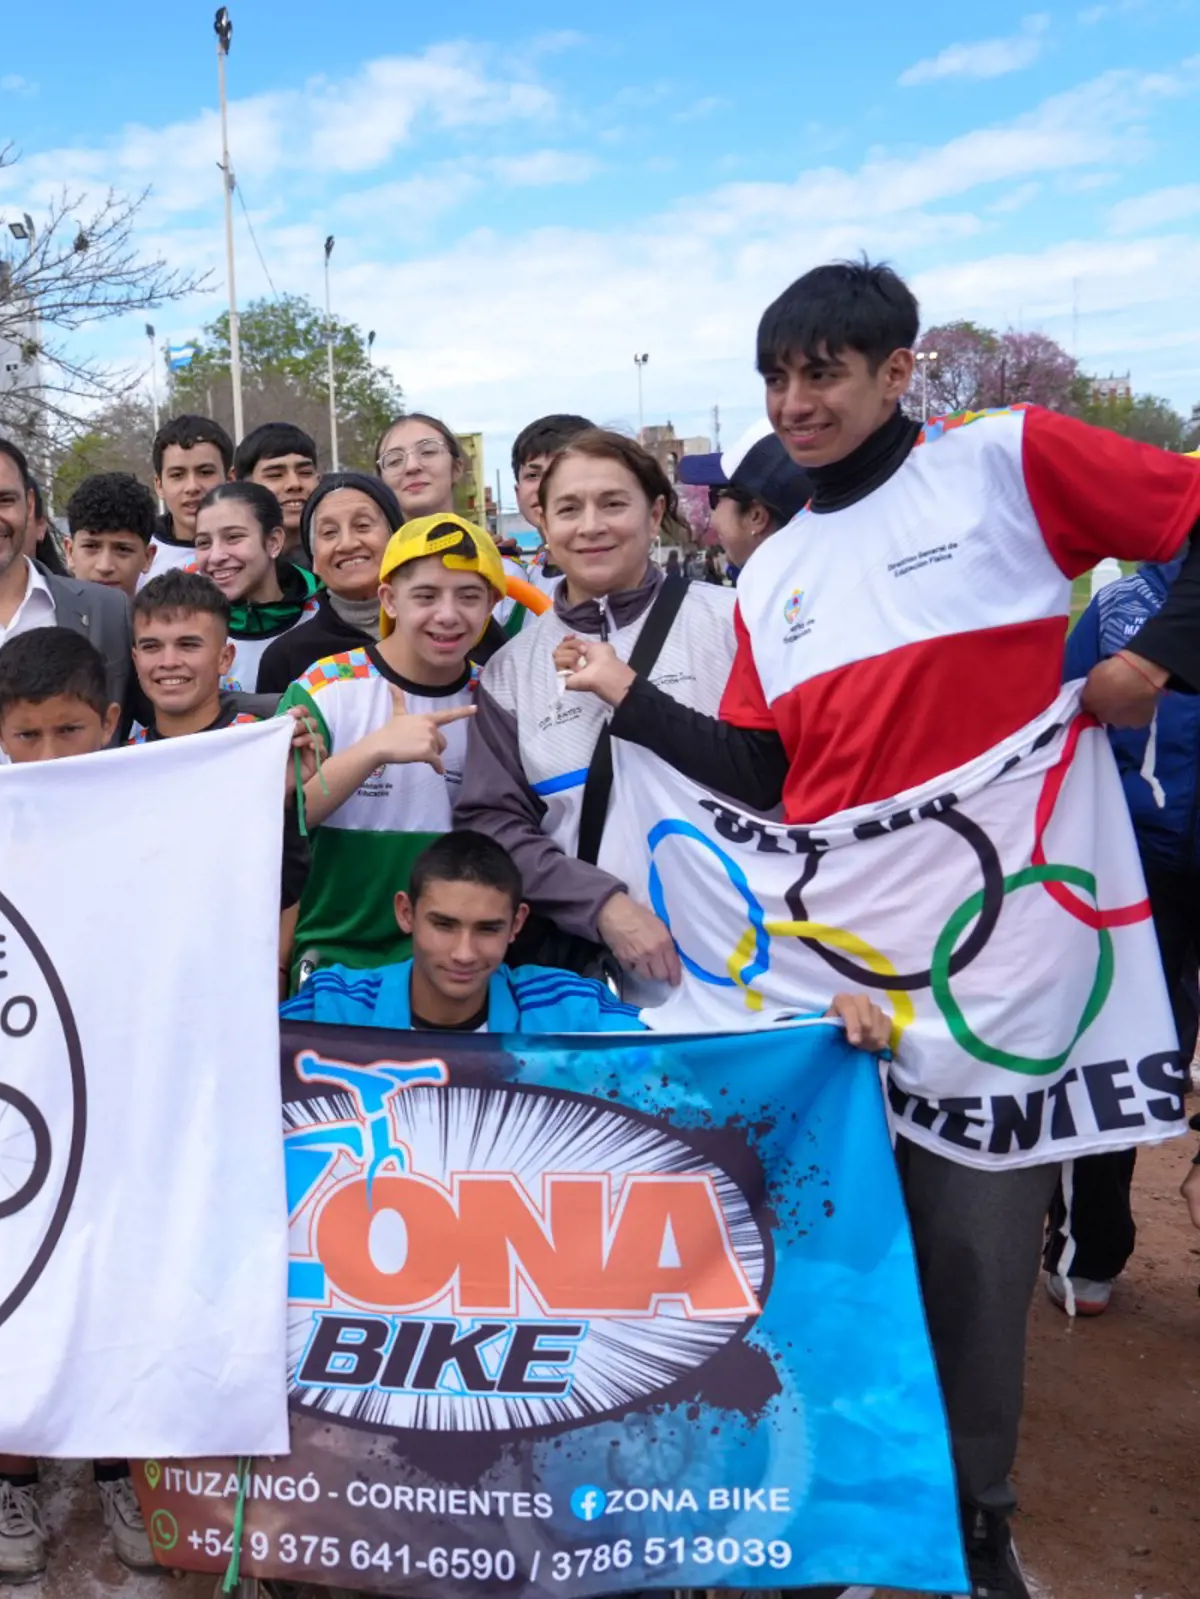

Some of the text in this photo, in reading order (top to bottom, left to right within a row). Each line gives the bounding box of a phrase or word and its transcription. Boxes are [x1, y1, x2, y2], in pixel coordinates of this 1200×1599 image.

[888, 1050, 1188, 1154] IENTES
[295, 1310, 590, 1399] BIKE
[346, 1481, 553, 1519] CORRIENTES
[604, 1488, 698, 1514] ZONA
[708, 1487, 792, 1512] BIKE
[250, 1530, 269, 1561] 9
[279, 1533, 340, 1567] 375
[349, 1539, 516, 1581] 641-6590
[551, 1539, 633, 1582] 3786
[643, 1535, 793, 1569] 513039
